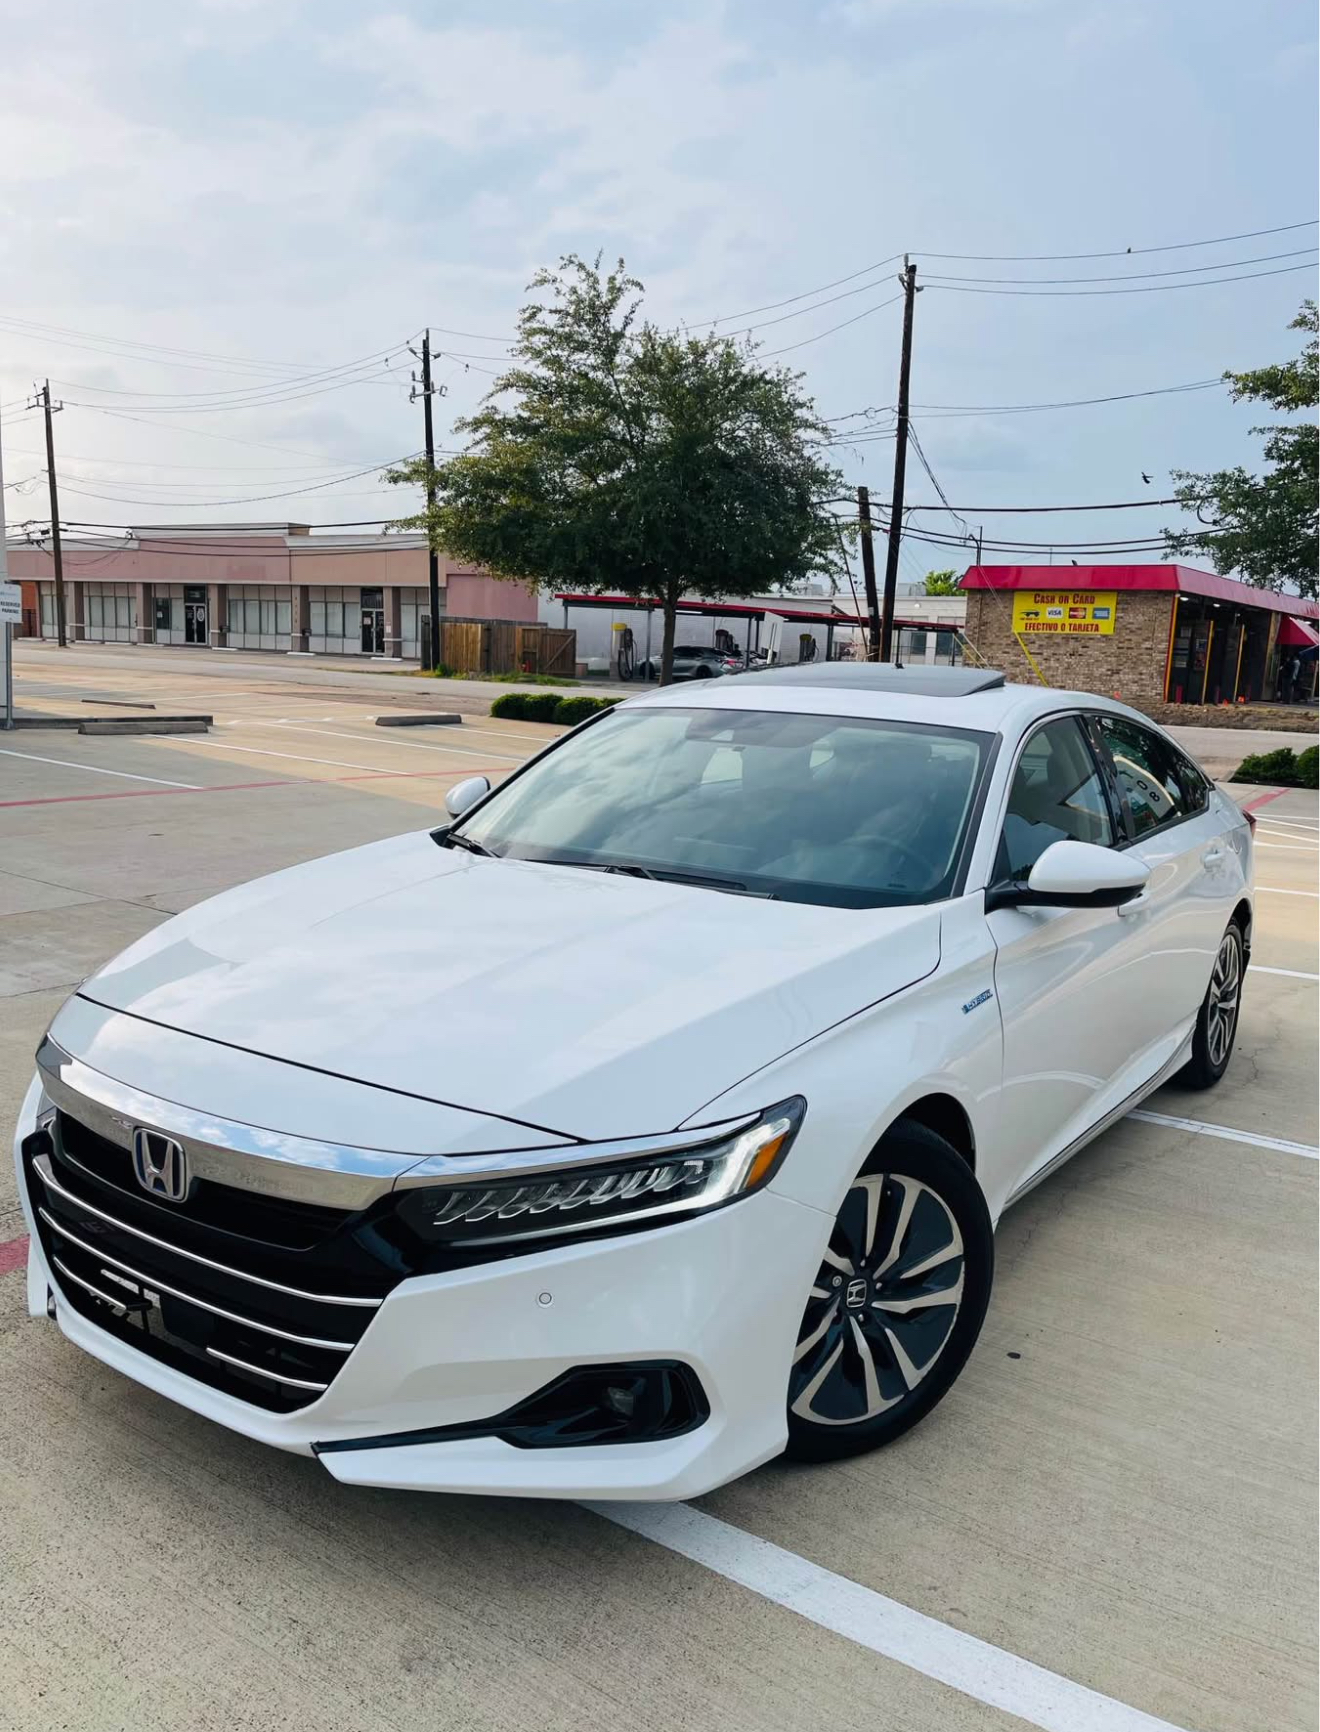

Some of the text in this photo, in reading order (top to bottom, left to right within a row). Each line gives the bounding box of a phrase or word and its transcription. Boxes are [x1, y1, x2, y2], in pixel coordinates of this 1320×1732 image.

[1034, 594, 1056, 604] CASH
[1073, 594, 1095, 604] CARD
[1025, 623, 1099, 632] EFECTIVO O TARJETA
